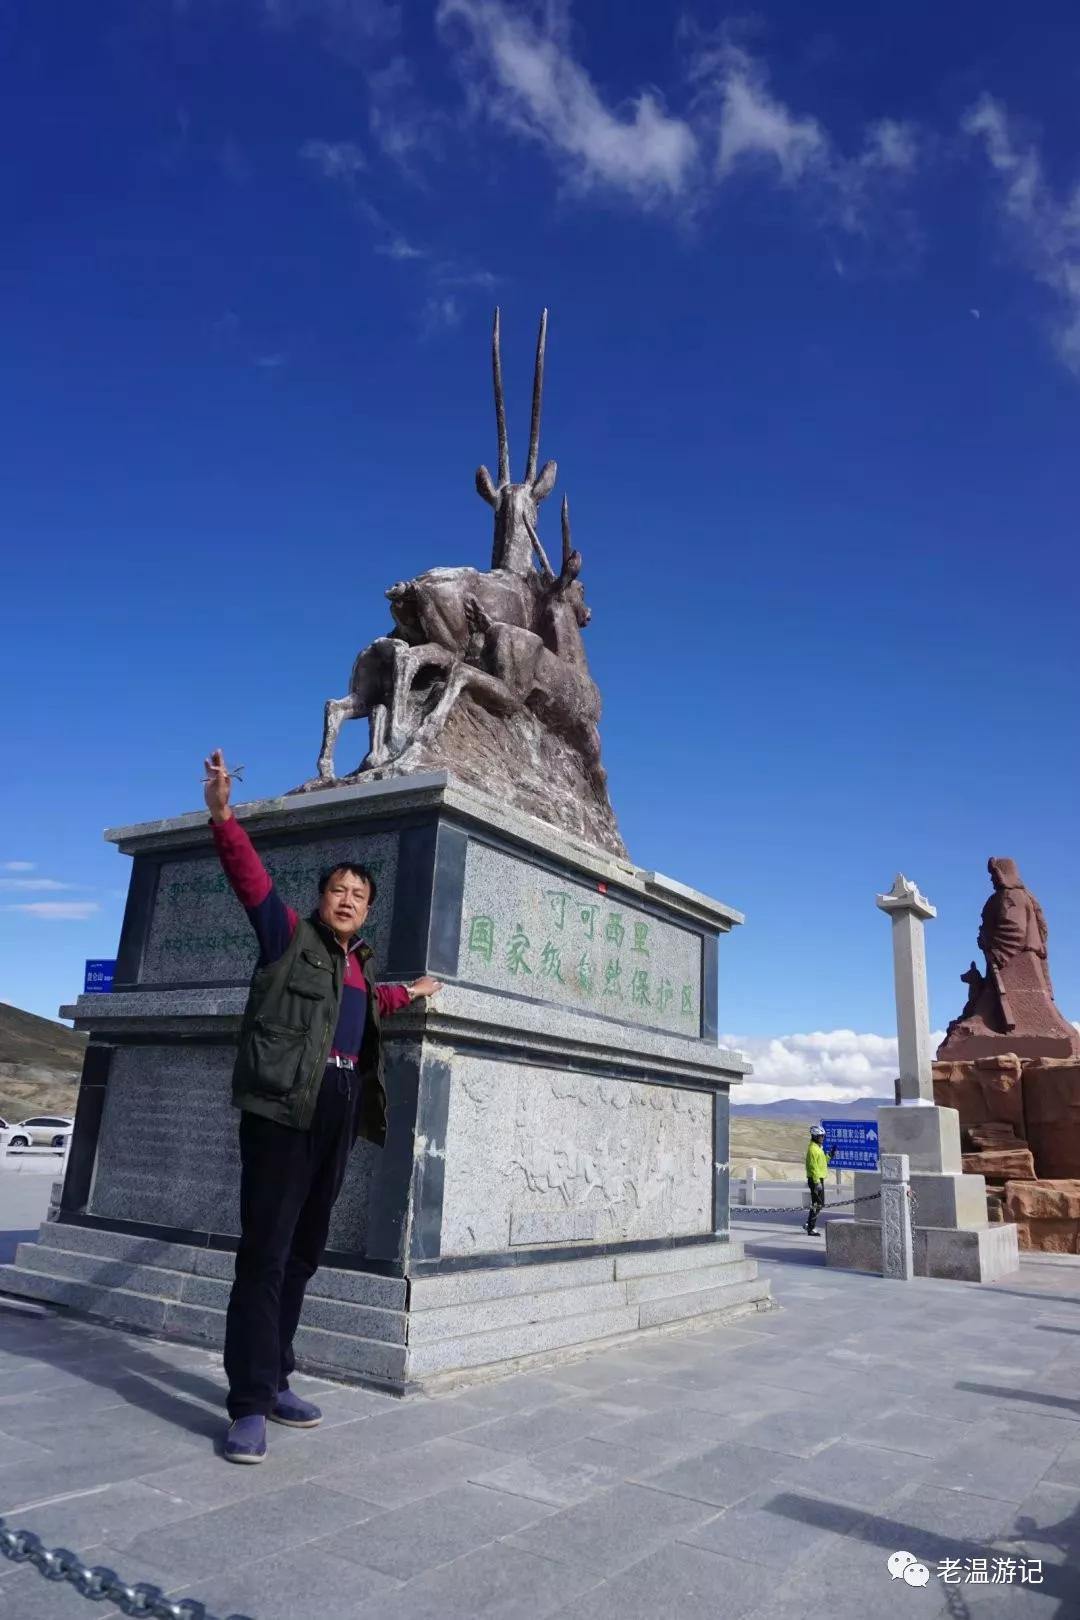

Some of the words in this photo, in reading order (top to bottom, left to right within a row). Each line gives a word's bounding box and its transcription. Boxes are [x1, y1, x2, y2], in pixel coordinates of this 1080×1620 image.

[544, 889, 649, 957] 可可西里
[468, 915, 694, 1016] 国家级自然保护区
